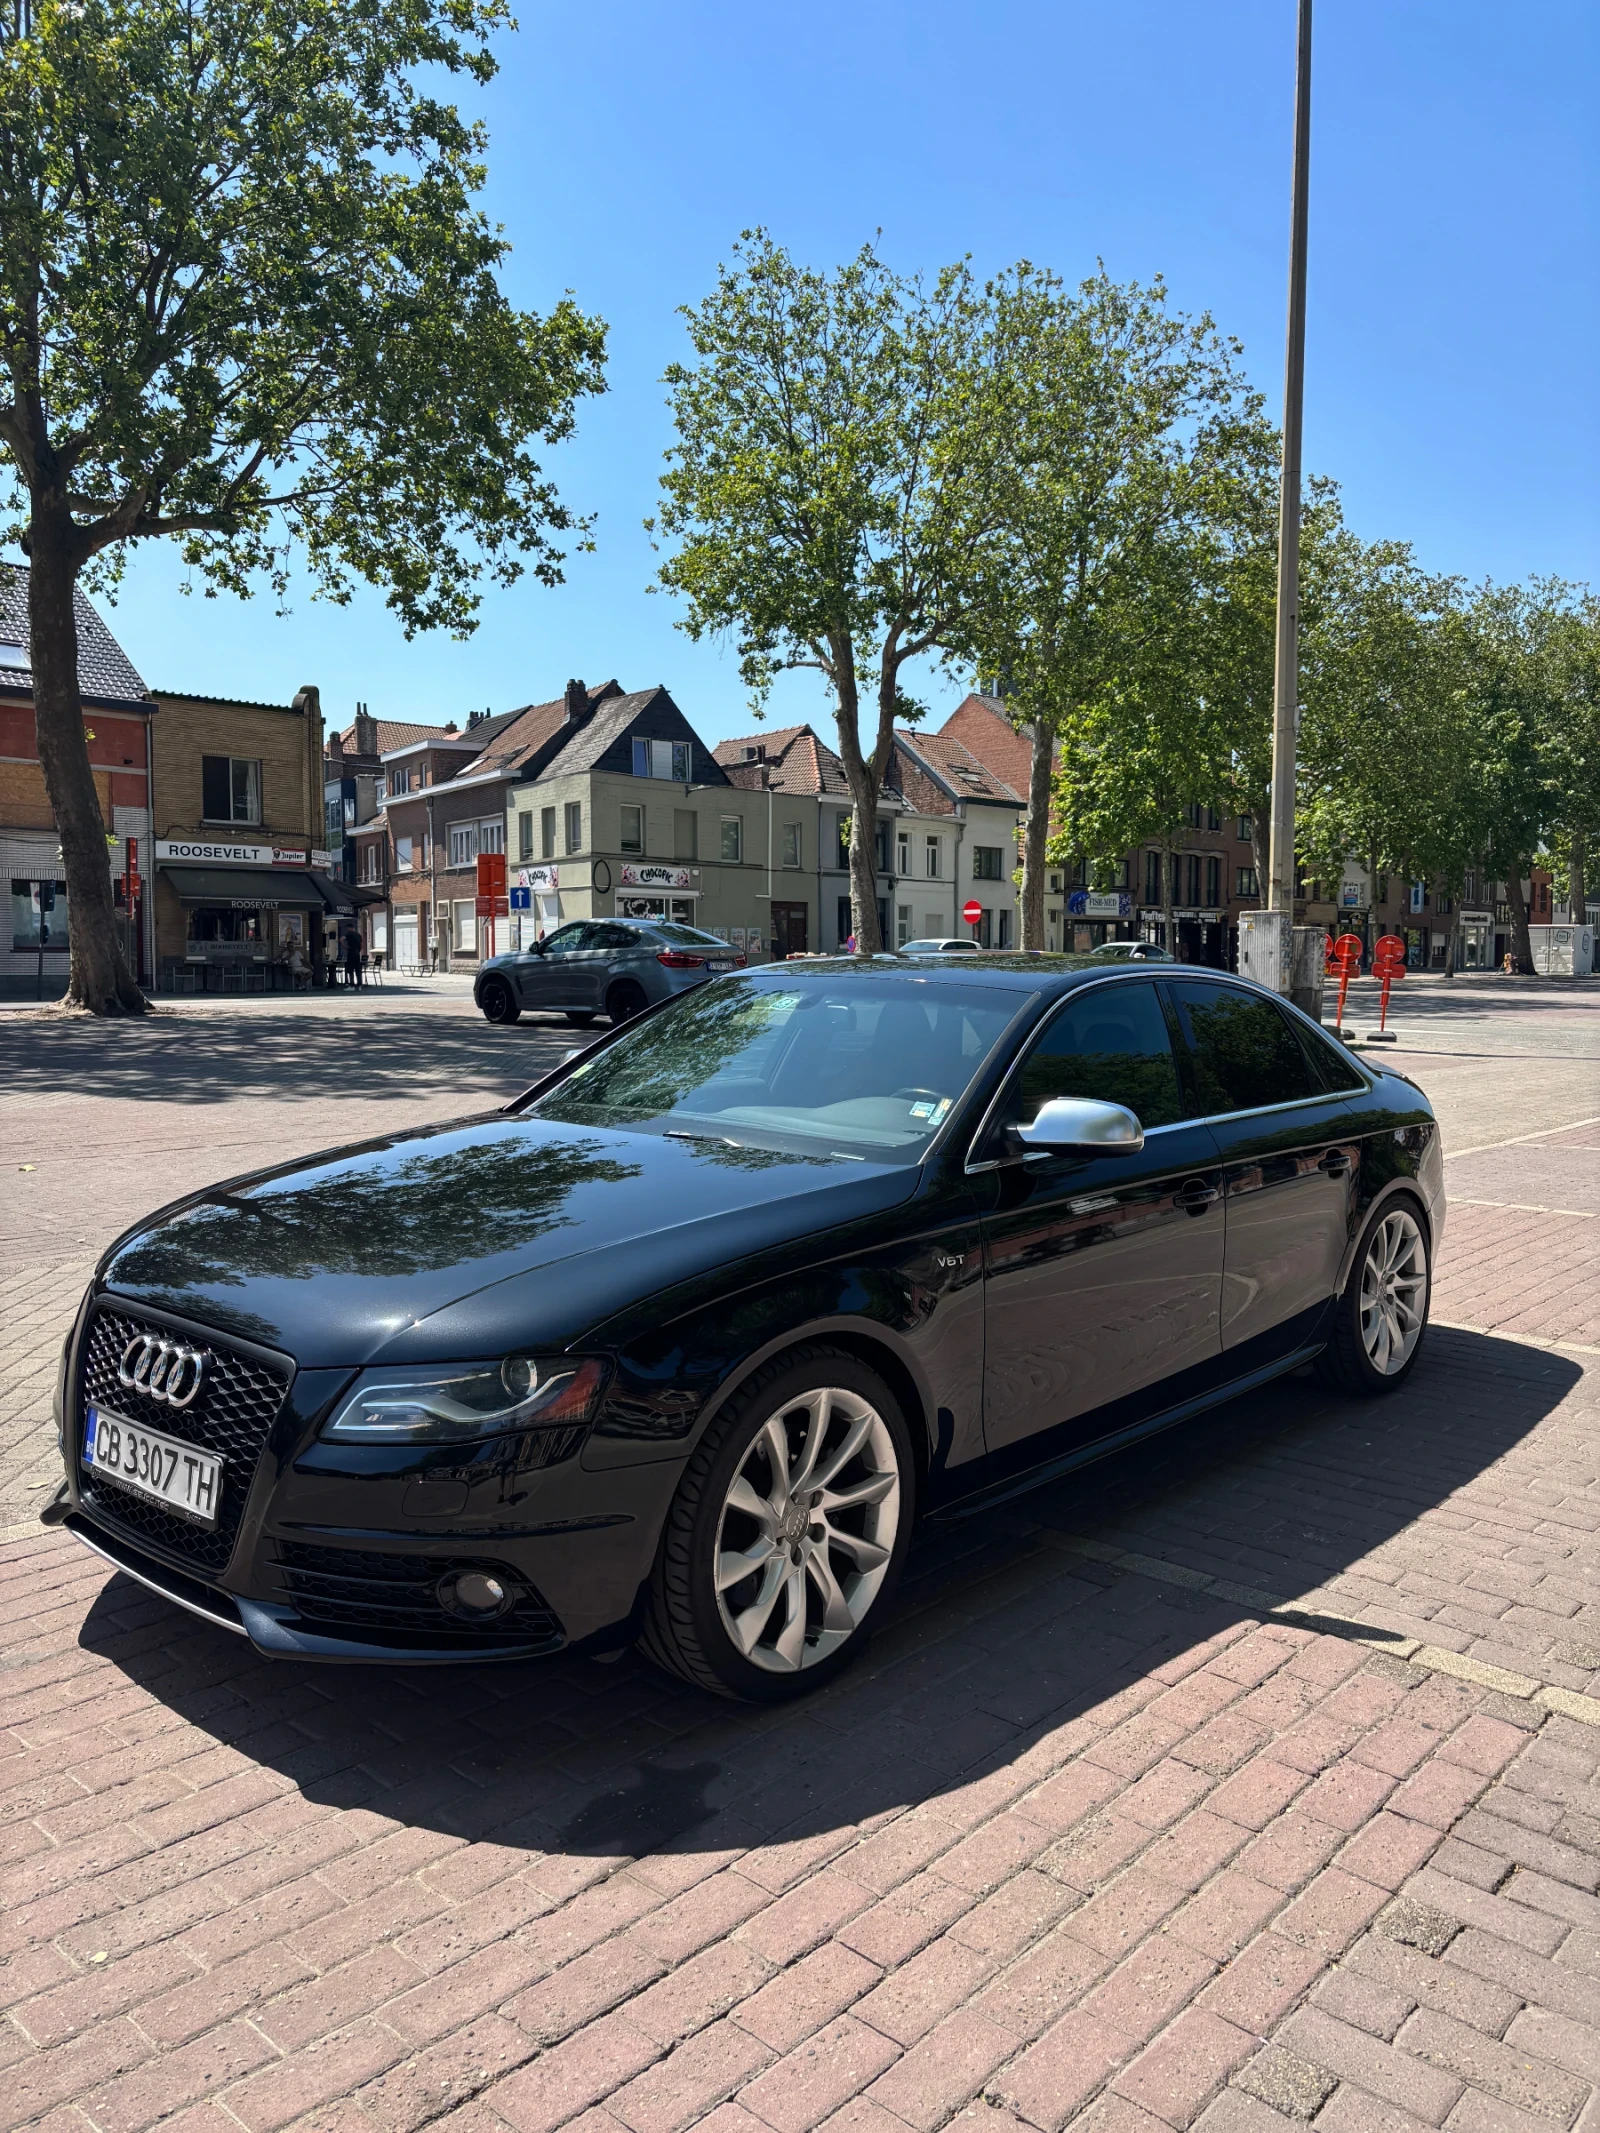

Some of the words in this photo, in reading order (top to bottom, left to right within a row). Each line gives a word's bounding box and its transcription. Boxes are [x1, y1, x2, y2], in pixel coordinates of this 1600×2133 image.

[169, 844, 260, 860] ROOSEVELT
[281, 852, 304, 860] Jupiler
[231, 900, 279, 909] ROOSEVELT
[1089, 897, 1117, 907] FISH-MED
[937, 1254, 964, 1267] V6T
[86, 1441, 93, 1454] BG
[97, 1420, 120, 1467] CB
[124, 1433, 178, 1490] 3307
[184, 1456, 214, 1510] TH
